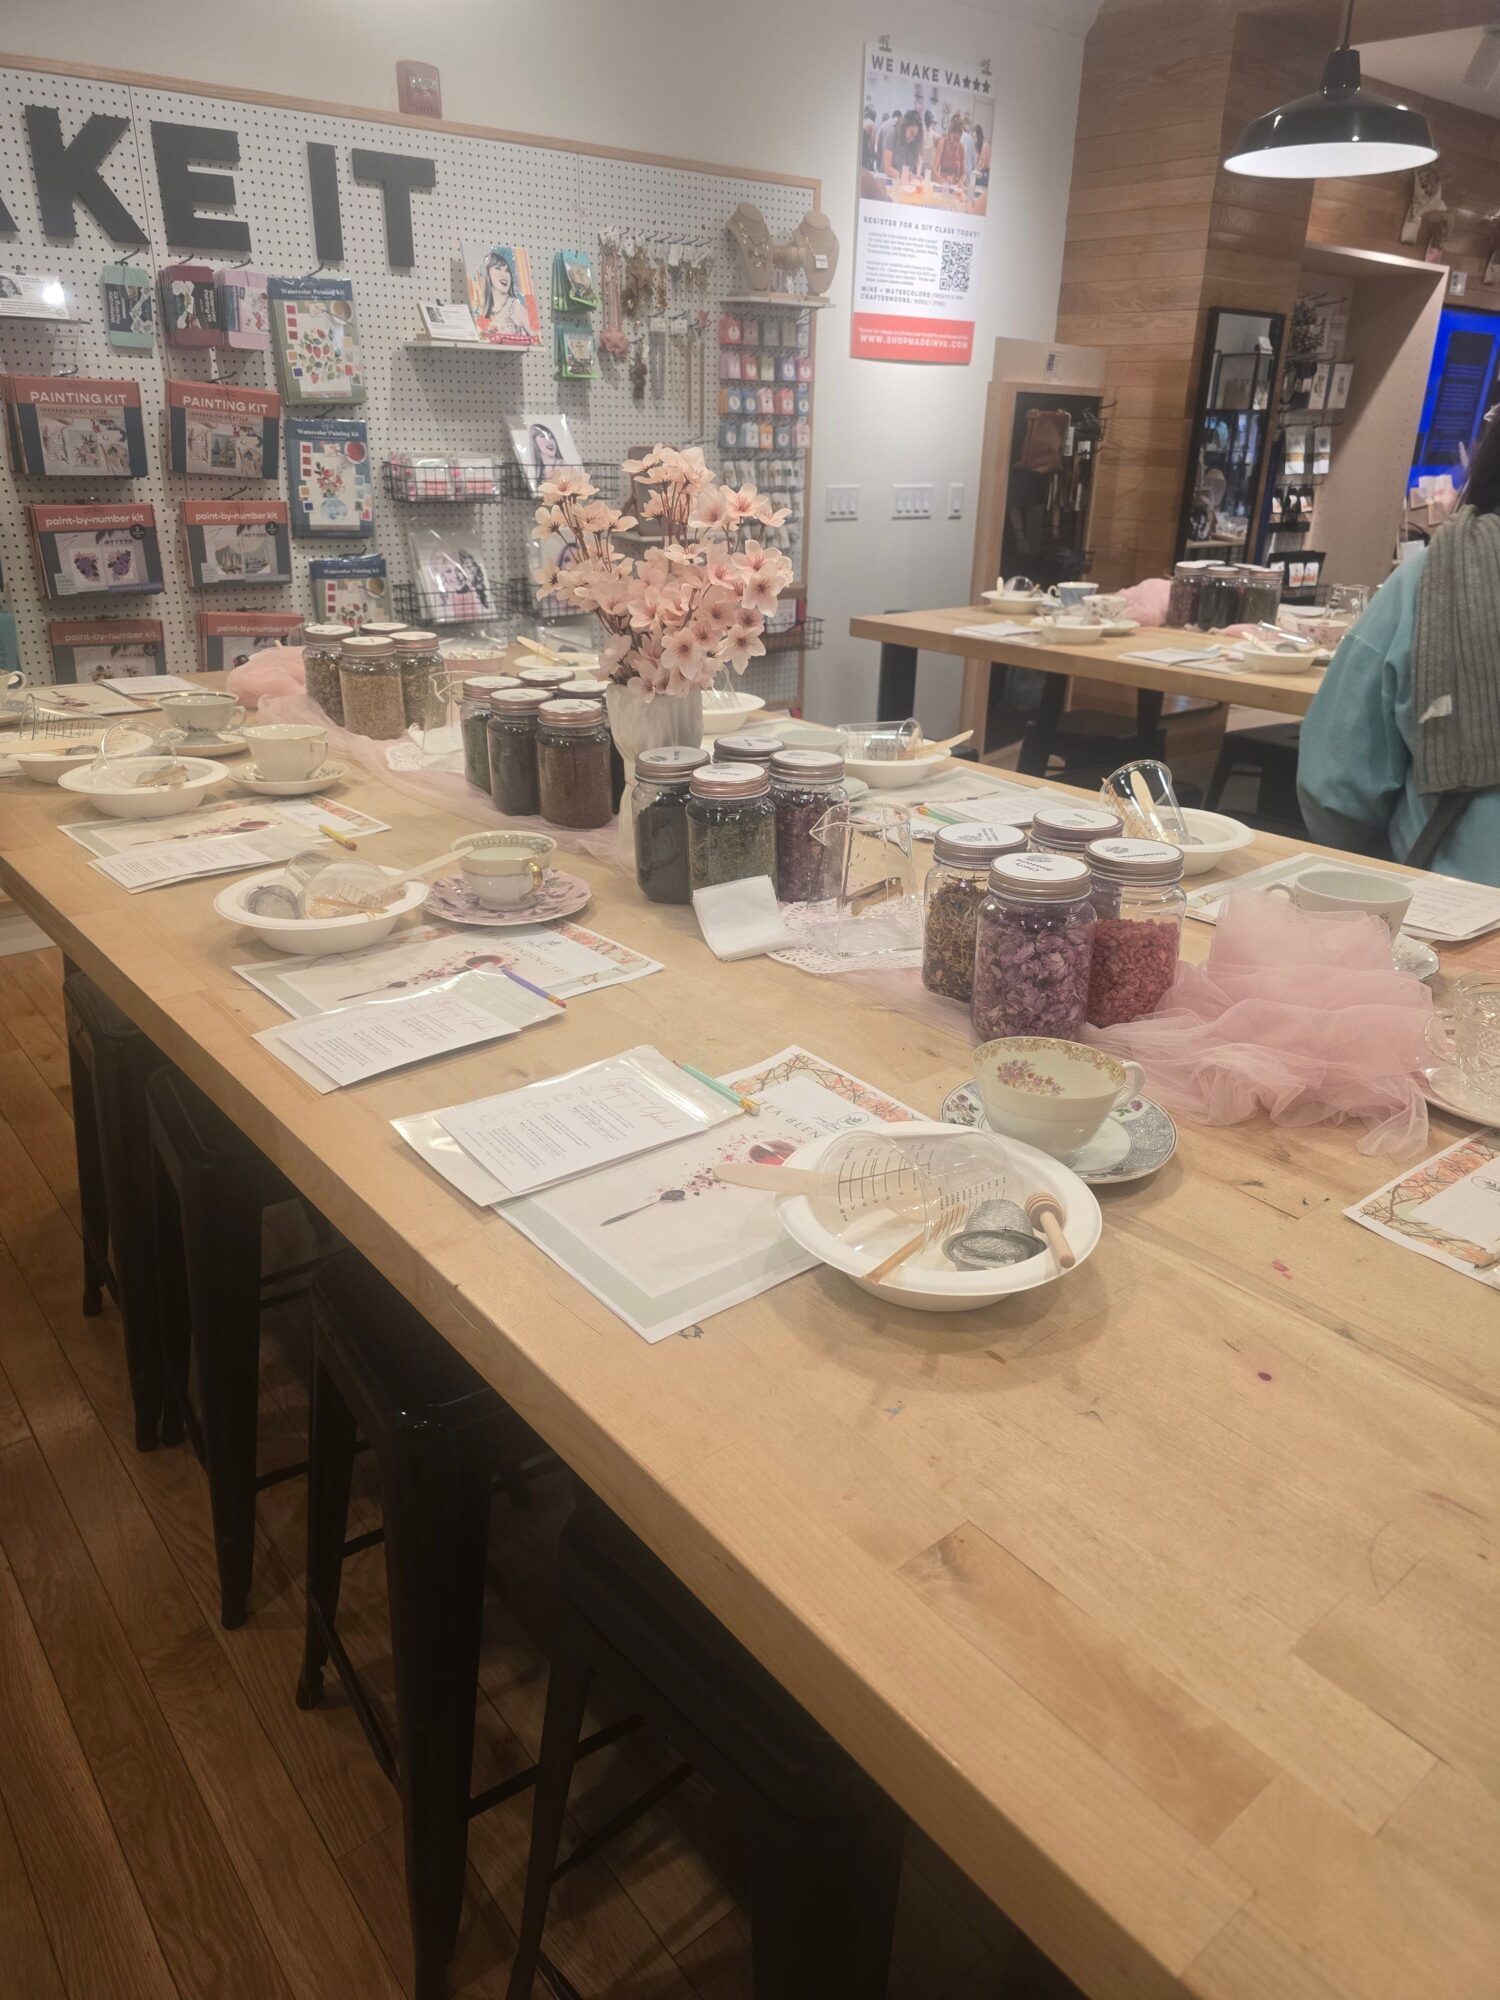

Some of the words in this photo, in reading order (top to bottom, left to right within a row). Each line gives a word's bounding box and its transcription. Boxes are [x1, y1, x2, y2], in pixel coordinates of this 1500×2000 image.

[871, 54, 894, 73] WE
[900, 61, 939, 83] MAKE
[0, 105, 252, 253] KE
[306, 141, 437, 268] IT
[863, 216, 898, 227] REGISTER
[899, 221, 913, 229] FOR
[921, 224, 932, 232] DIY
[935, 226, 955, 235] CLASS
[30, 392, 102, 404] PAINTING
[104, 394, 126, 404] KIT
[183, 396, 246, 412] PAINTING
[248, 402, 268, 414] KIT
[46, 513, 130, 526] paint-by-number
[132, 512, 144, 522] kit
[195, 512, 266, 521] paint-by-number
[267, 512, 278, 520] kit
[64, 632, 144, 642] paint-by-number
[145, 630, 157, 638] kit
[760, 1100, 782, 1117] TEA
[786, 1117, 822, 1138] BLEN
